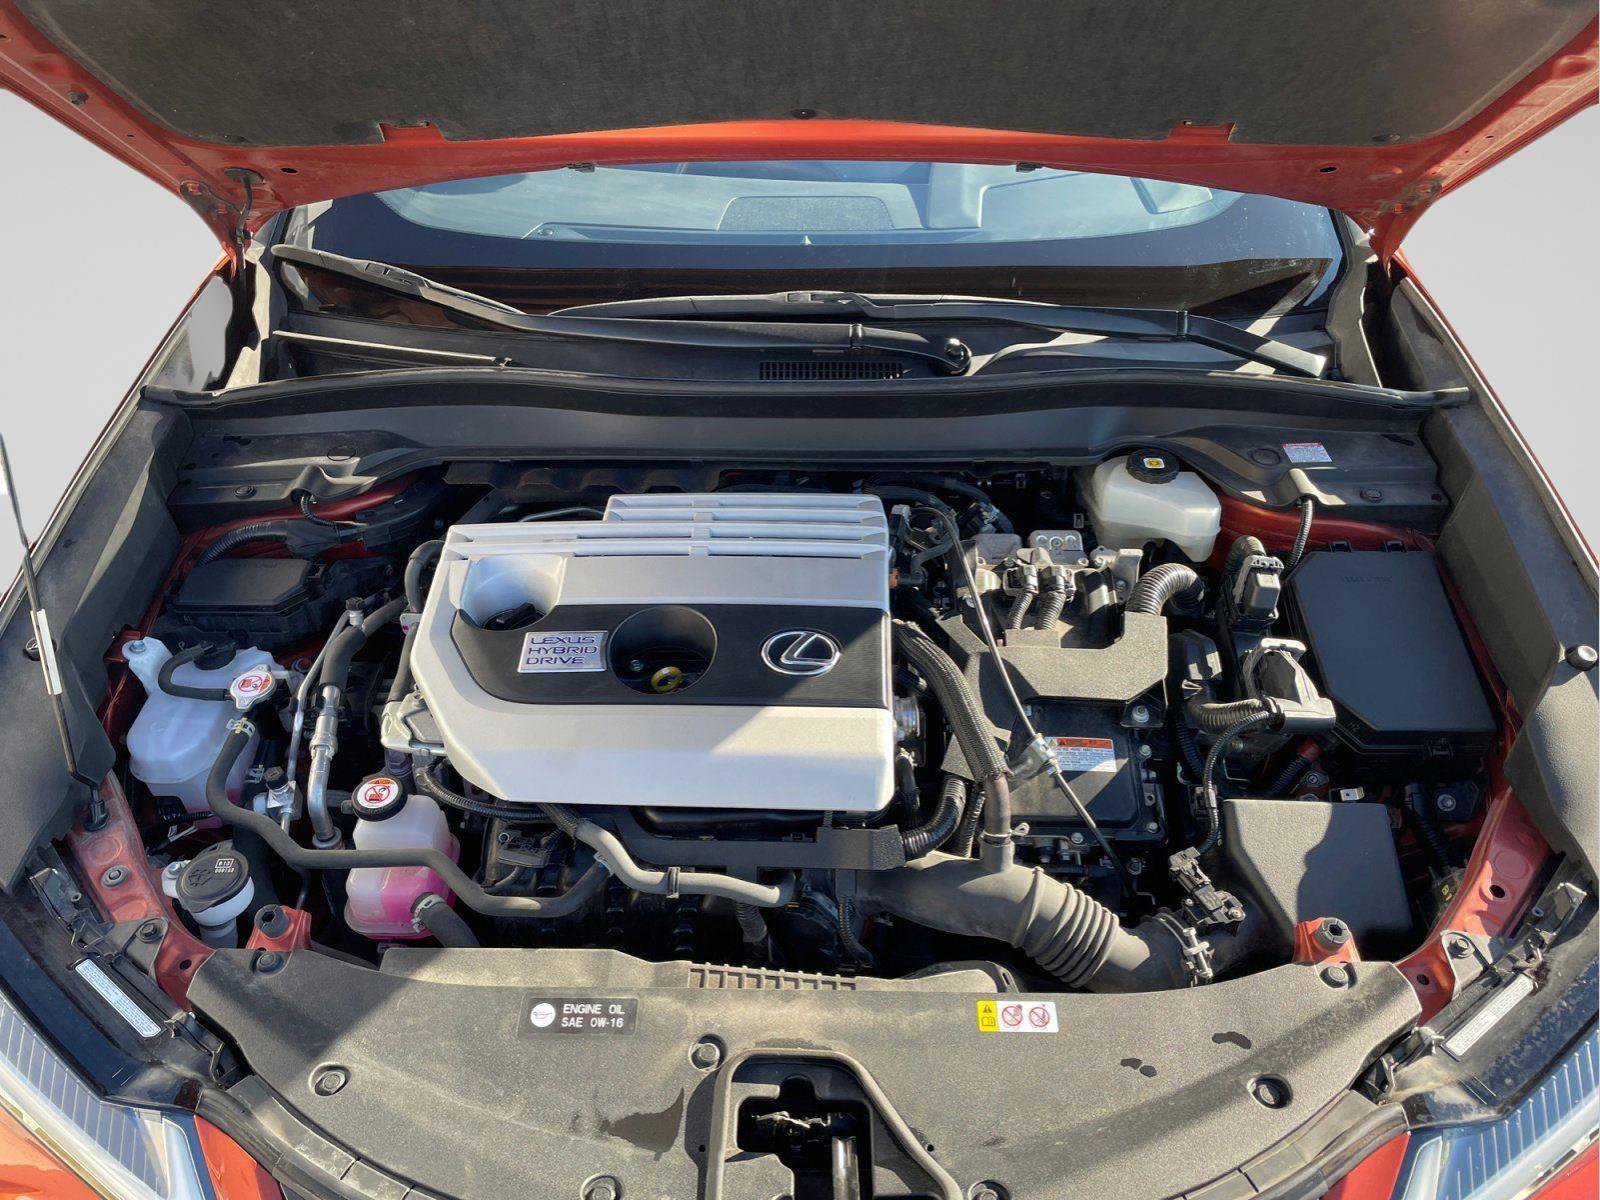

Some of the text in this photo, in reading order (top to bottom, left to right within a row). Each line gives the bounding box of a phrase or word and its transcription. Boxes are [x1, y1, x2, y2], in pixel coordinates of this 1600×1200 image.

[531, 636, 595, 645] LEXUS
[528, 646, 598, 655] HYBRID
[526, 656, 585, 665] DRIVE
[563, 1003, 626, 1015] ENGINE OIL
[561, 1017, 625, 1028] SAE 0W-16
